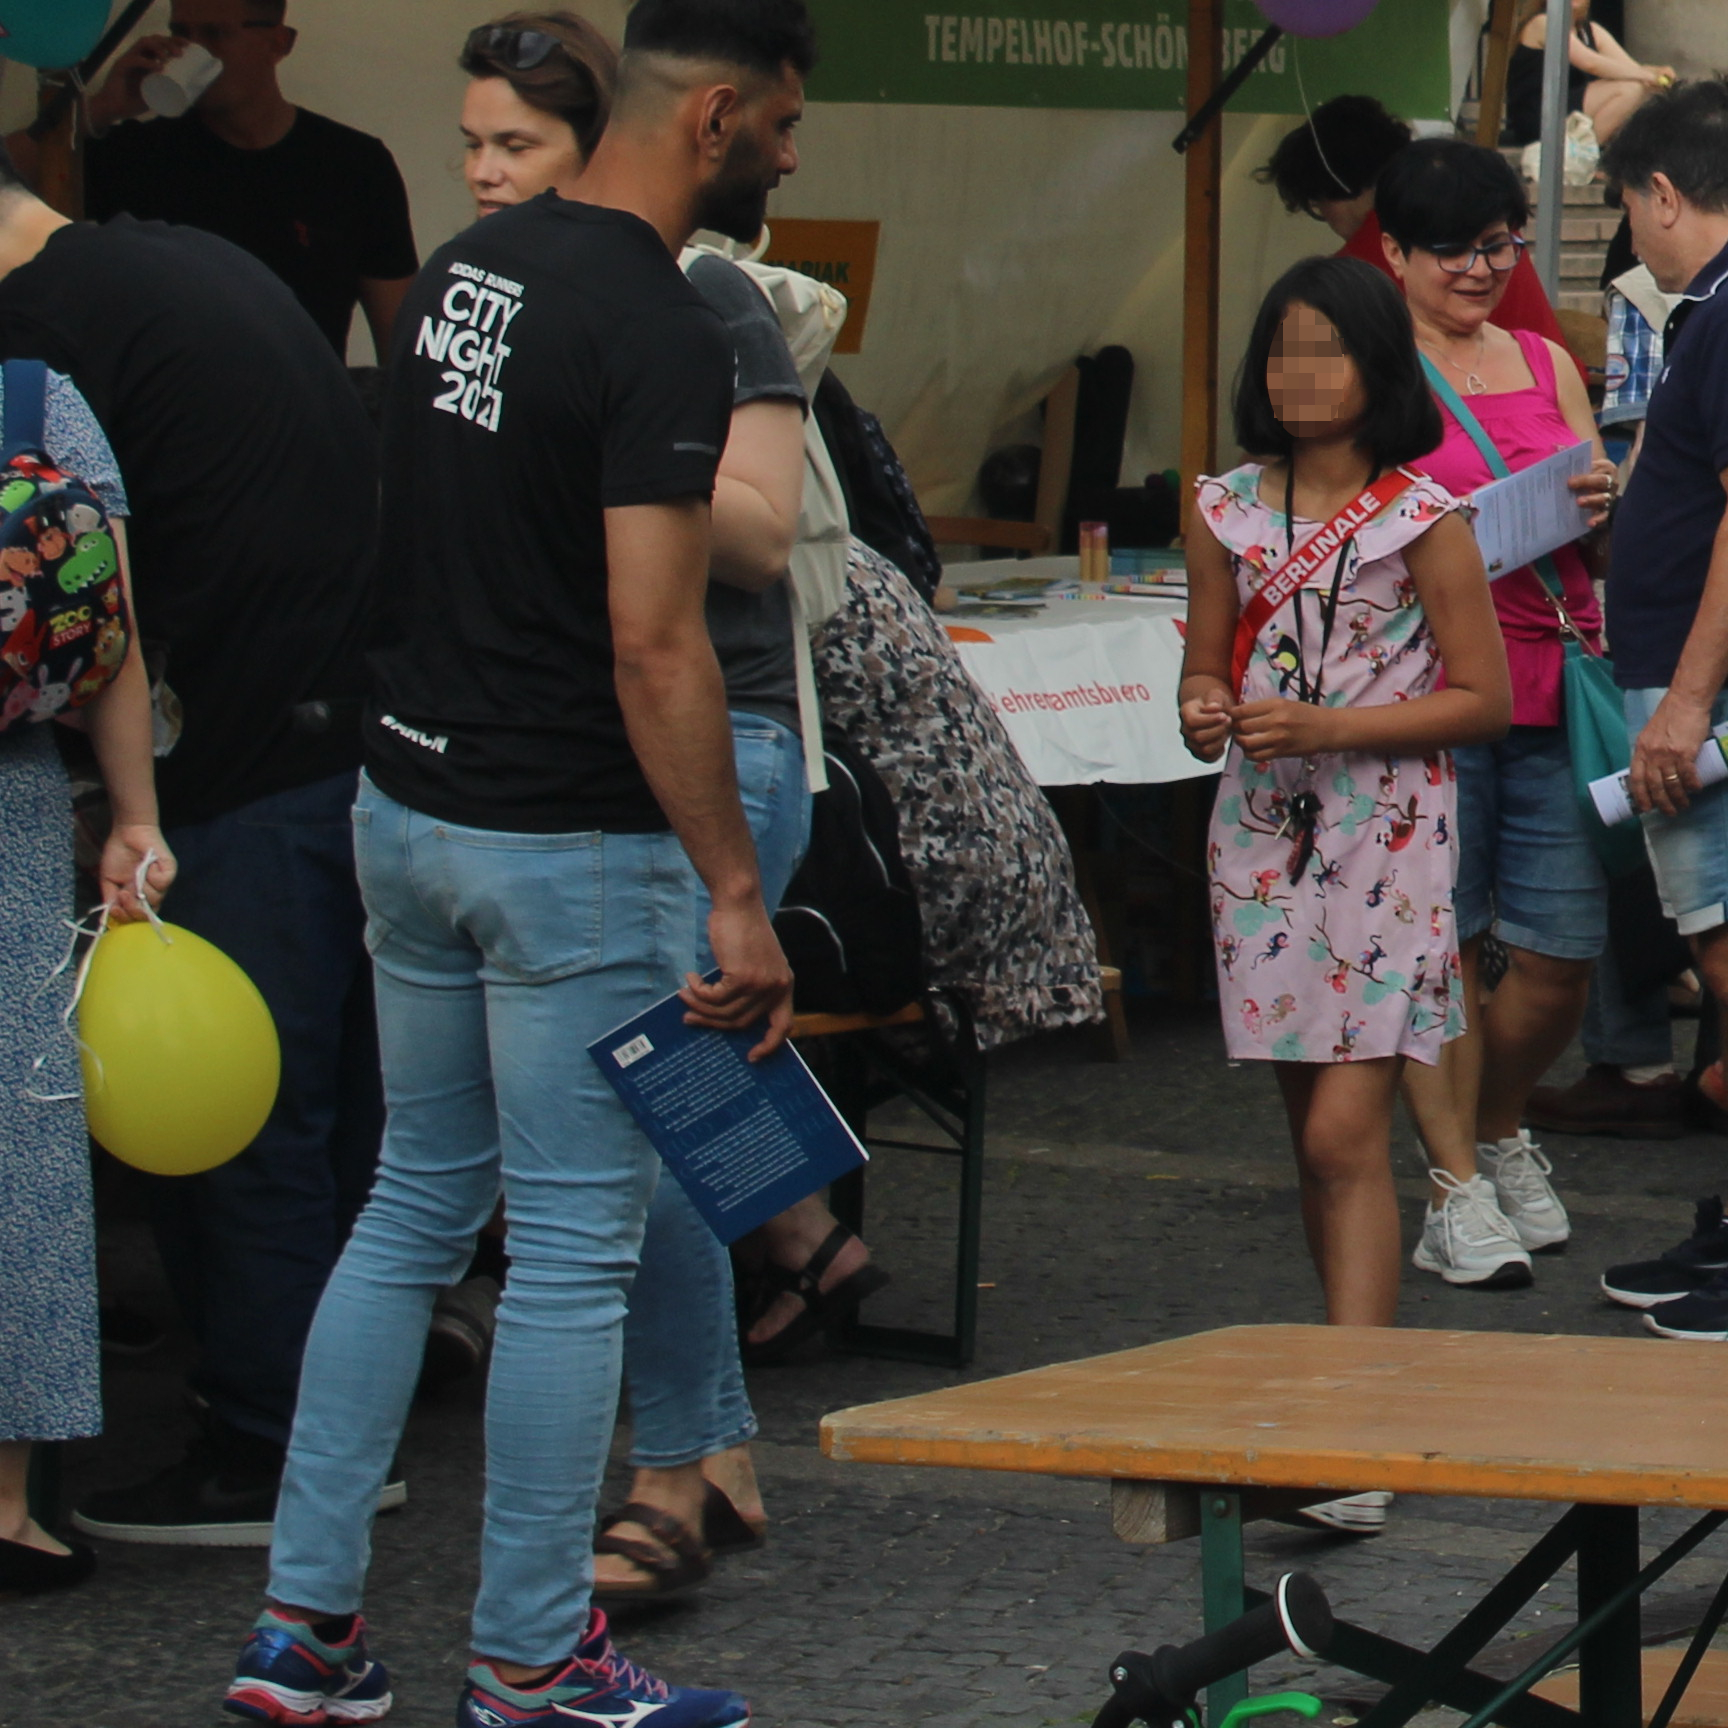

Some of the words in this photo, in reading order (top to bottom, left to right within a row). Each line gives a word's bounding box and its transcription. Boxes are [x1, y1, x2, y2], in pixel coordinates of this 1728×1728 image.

[924, 13, 1286, 74] TEMPELHOF-SCHÖNBERG
[442, 280, 524, 336] CITY
[484, 272, 525, 298] RUNNERS
[415, 315, 512, 388] NIGHT
[433, 370, 503, 433] 2021
[1261, 491, 1382, 608] BERLINALE
[49, 604, 92, 634] ZOO
[53, 622, 91, 647] STORY
